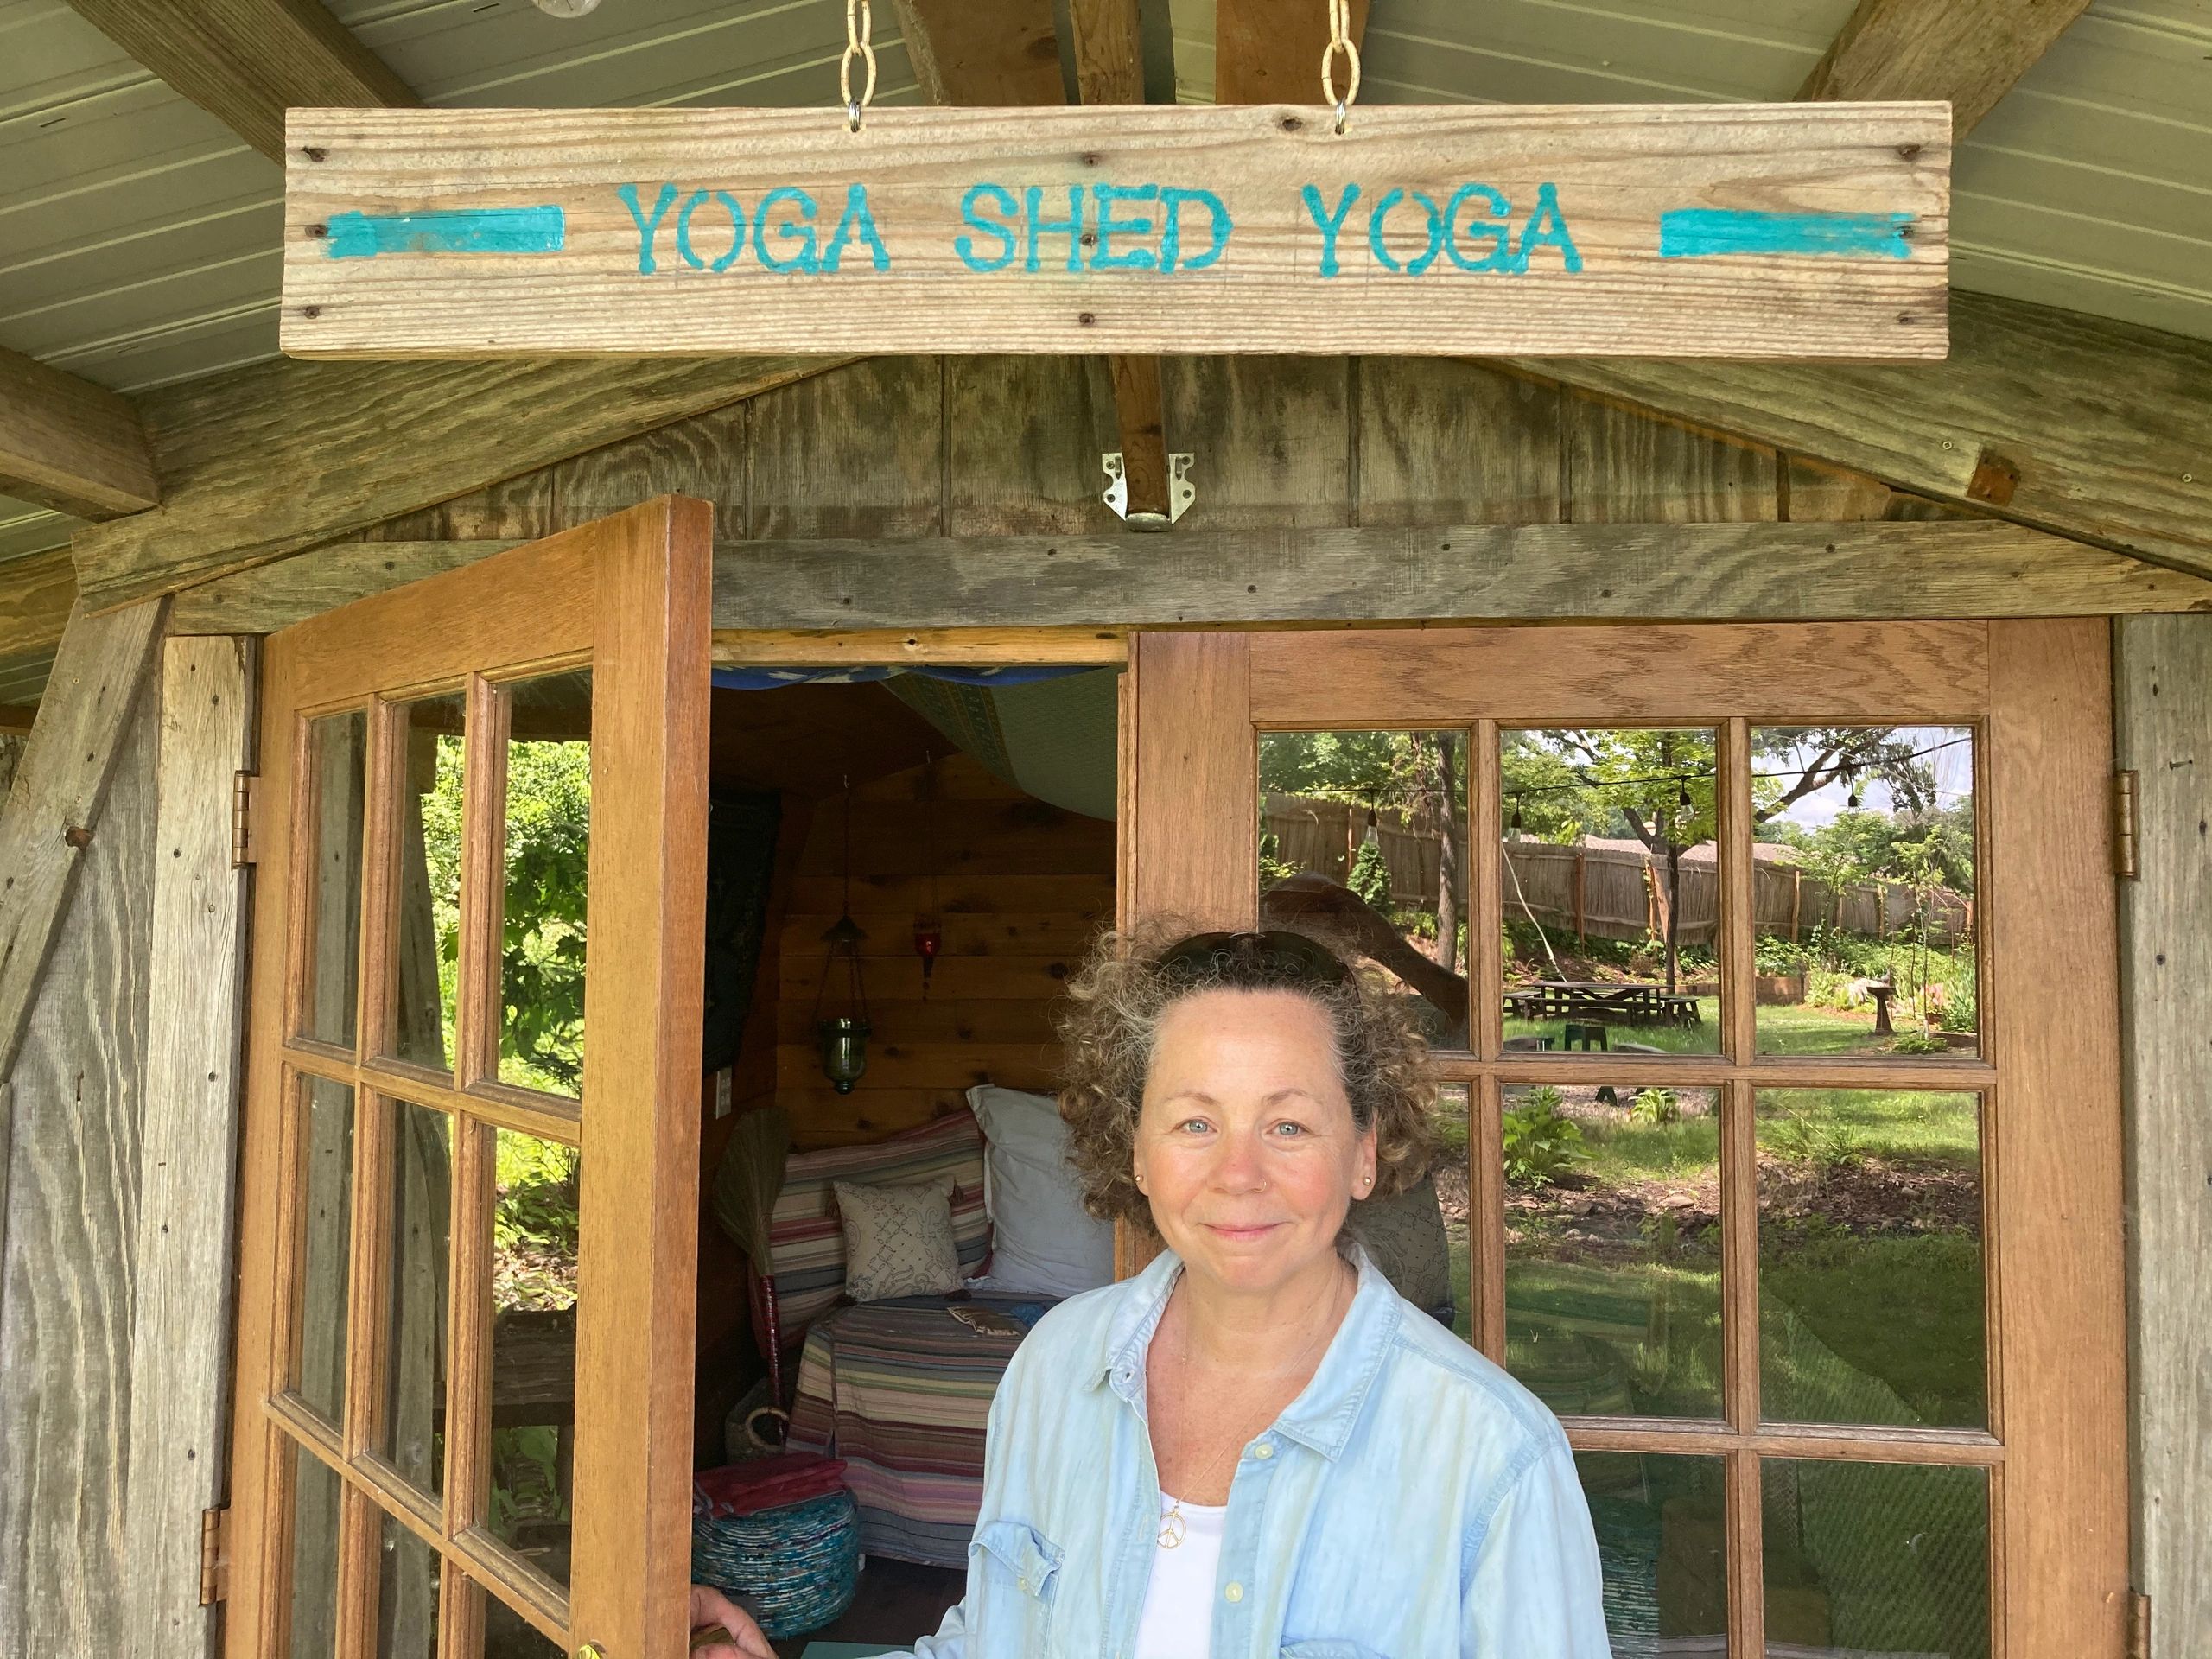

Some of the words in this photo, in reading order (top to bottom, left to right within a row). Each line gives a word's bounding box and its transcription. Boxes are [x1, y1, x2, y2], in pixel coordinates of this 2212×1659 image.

[618, 182, 891, 275] YOGA
[954, 182, 1235, 275] SHED
[1300, 181, 1584, 277] YOGA
